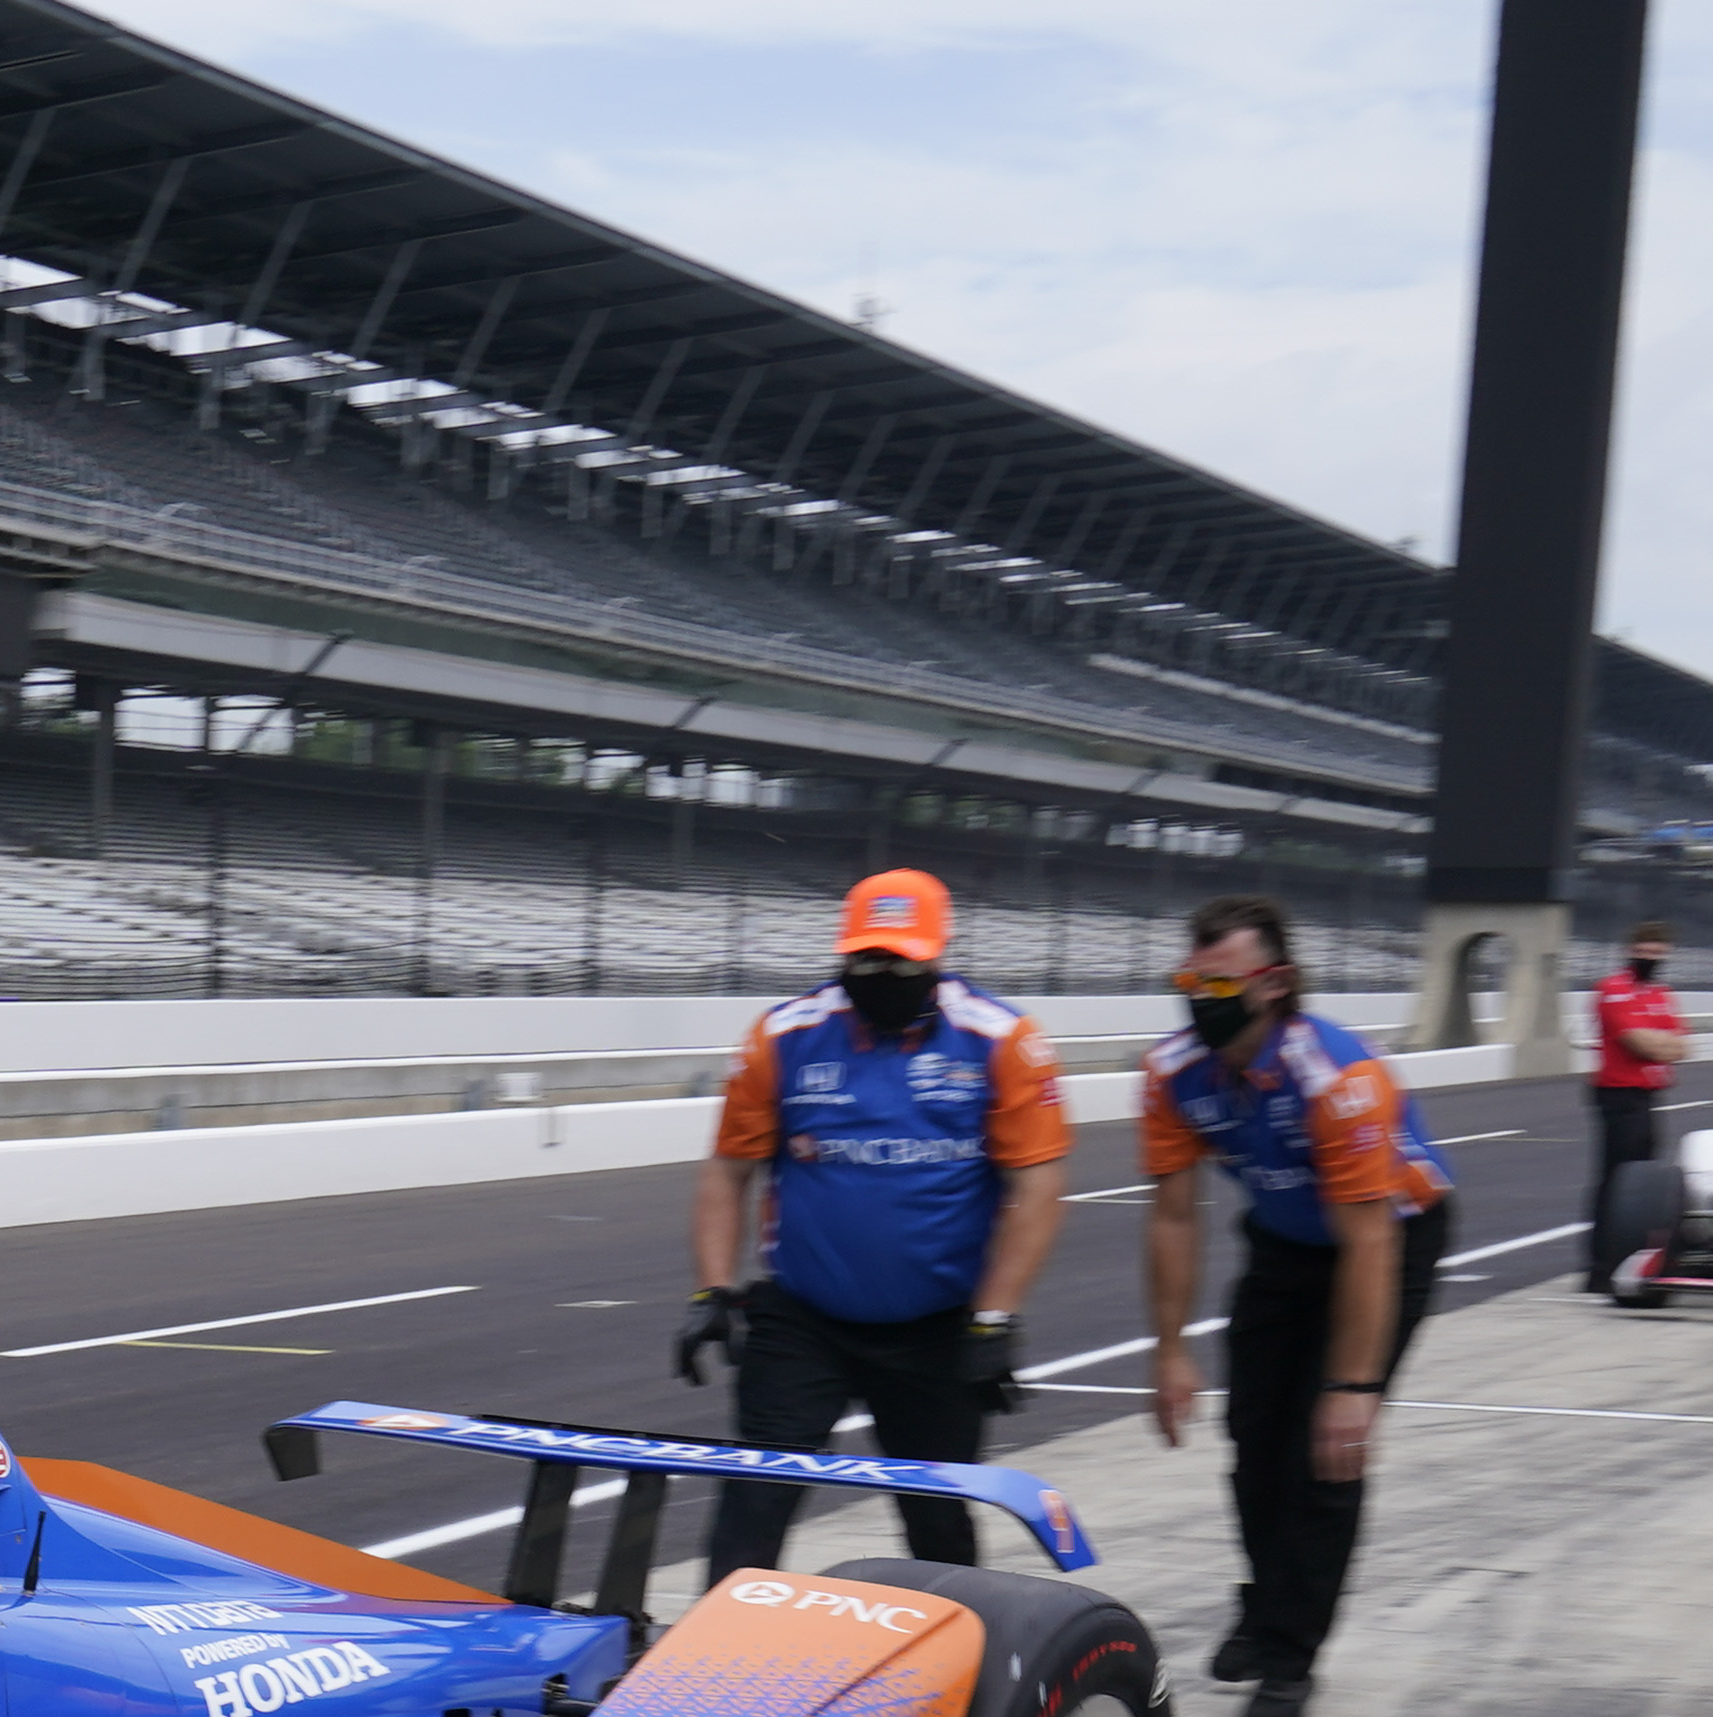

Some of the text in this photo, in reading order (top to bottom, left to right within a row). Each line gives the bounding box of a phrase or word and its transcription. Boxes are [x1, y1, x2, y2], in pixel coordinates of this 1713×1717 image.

[442, 1421, 924, 1481] PNCBANK
[793, 1589, 928, 1634] PNC
[180, 1632, 265, 1669] POWERED
